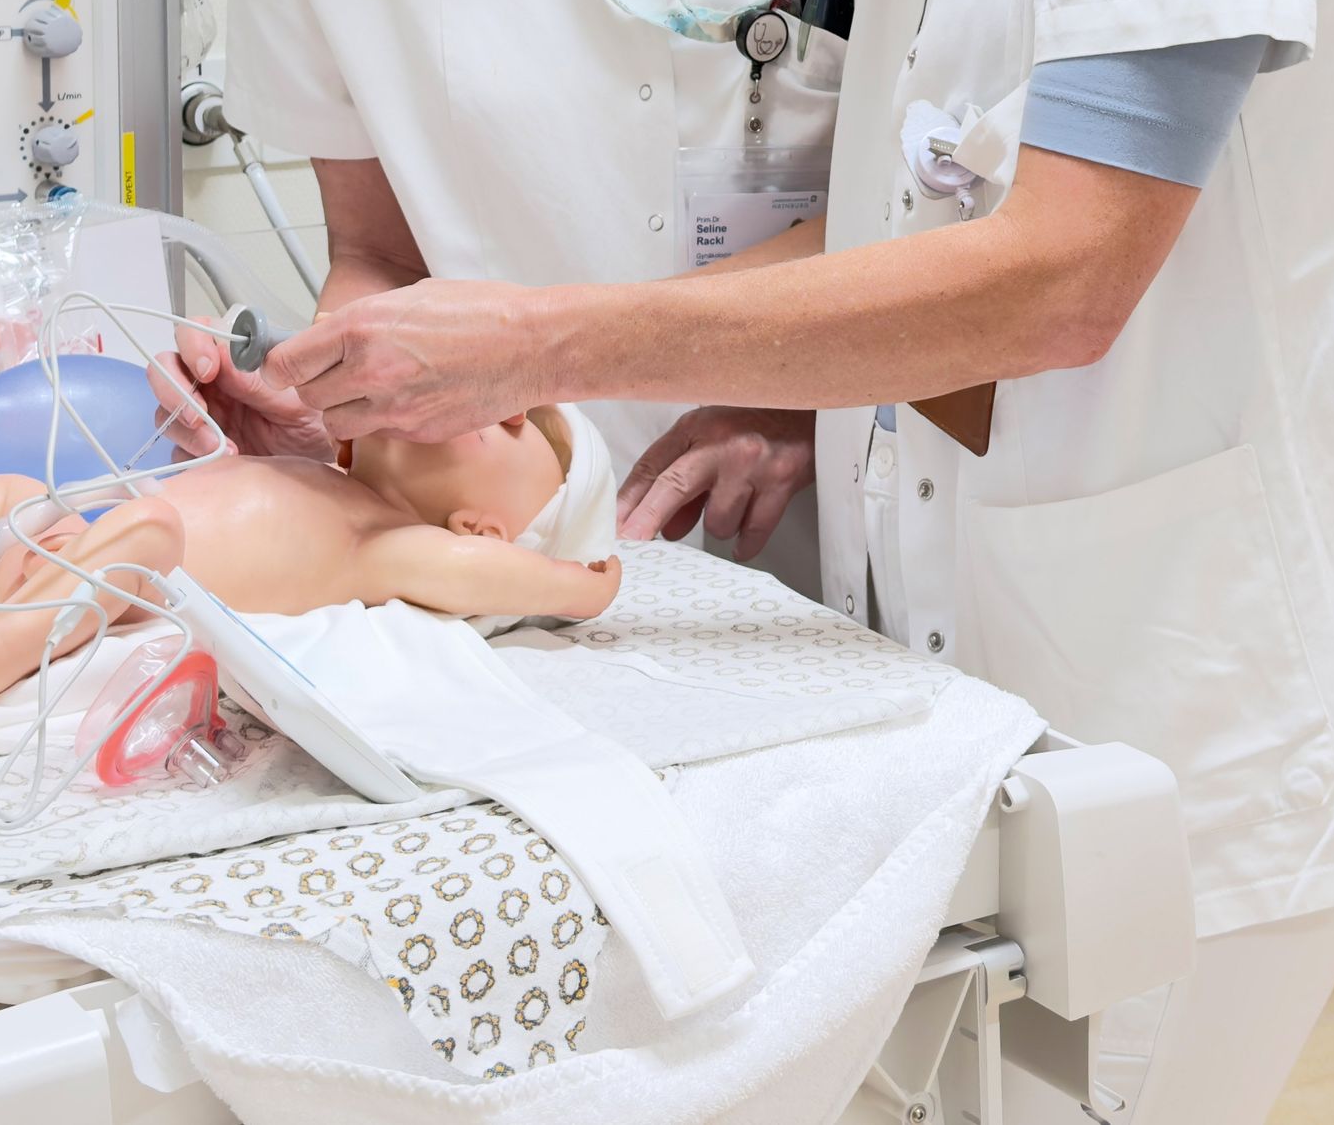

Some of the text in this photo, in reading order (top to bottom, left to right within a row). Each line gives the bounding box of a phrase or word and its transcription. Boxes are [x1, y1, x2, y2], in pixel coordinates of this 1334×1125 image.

[57, 91, 83, 101] L/min
[696, 224, 728, 234] Seline
[696, 236, 724, 246] Rackl
